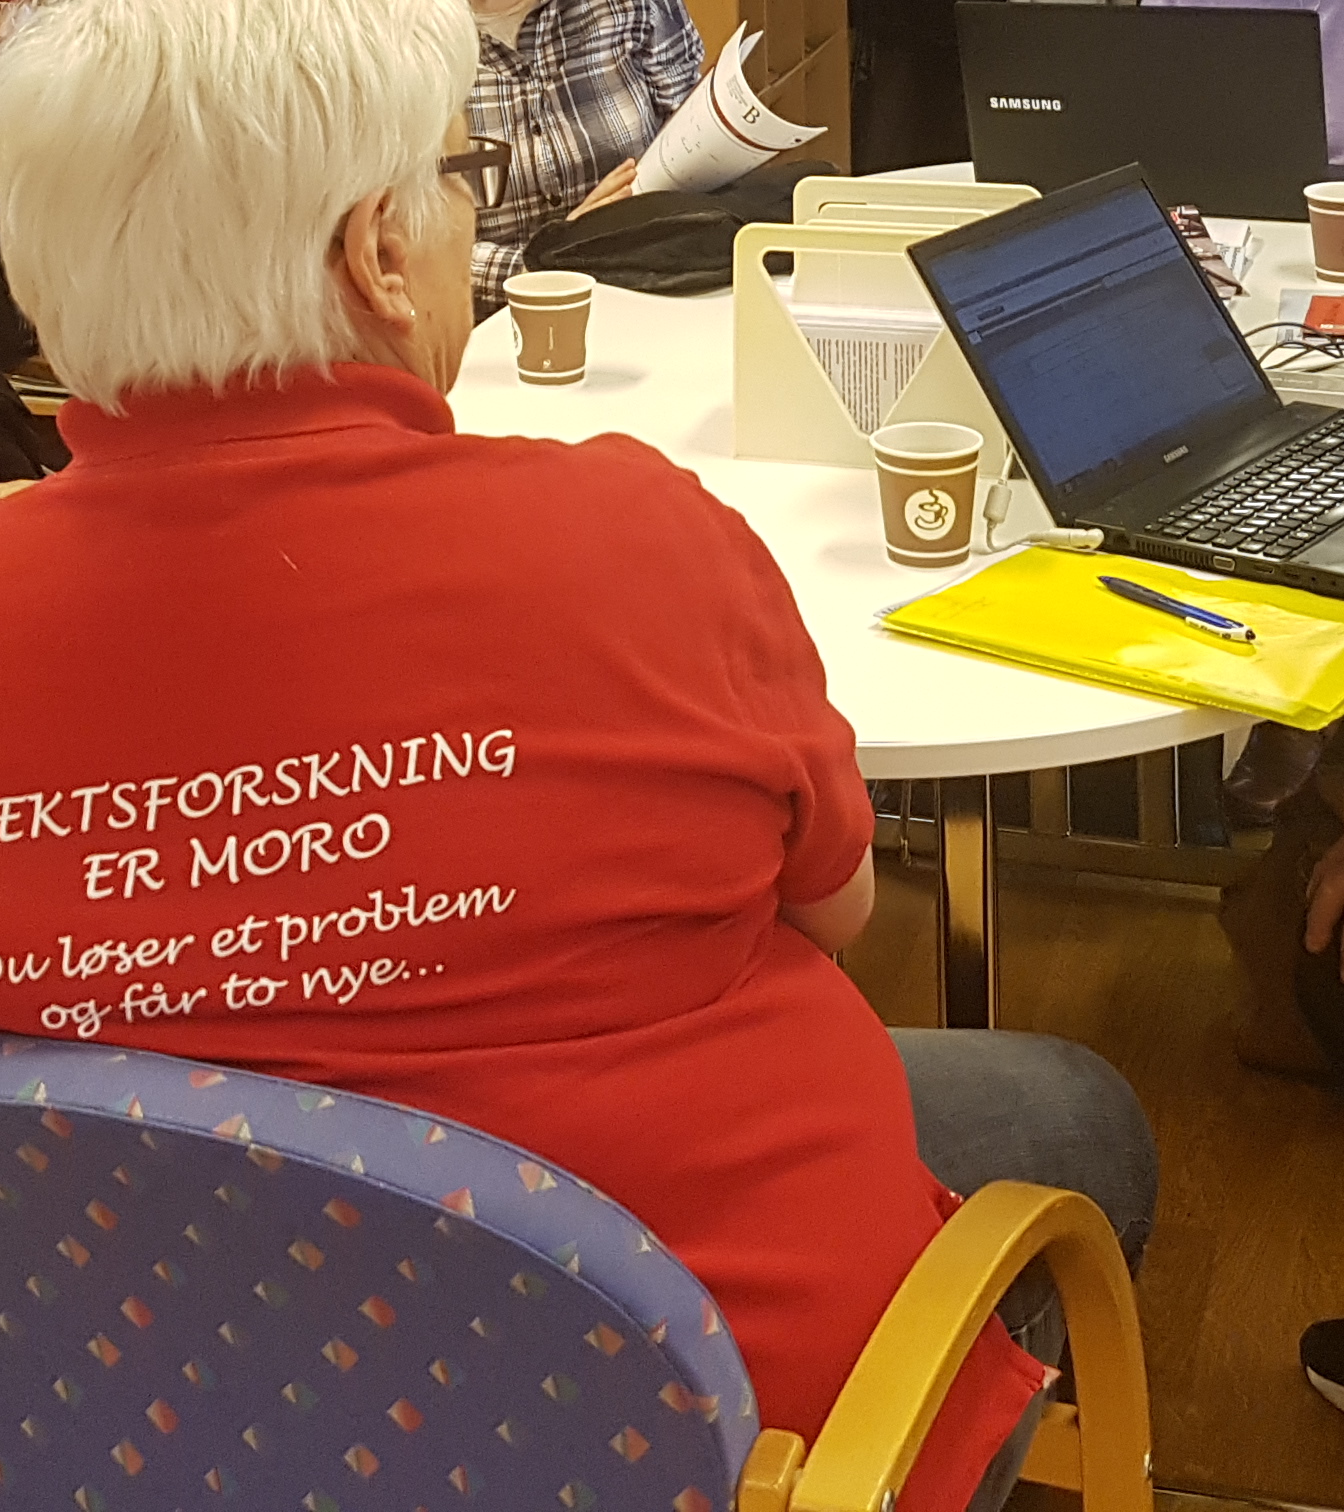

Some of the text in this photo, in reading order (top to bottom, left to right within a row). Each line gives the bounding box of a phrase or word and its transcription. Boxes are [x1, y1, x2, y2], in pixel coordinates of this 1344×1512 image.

[742, 105, 760, 124] B
[989, 97, 1062, 111] SAMSUNG
[83, 812, 392, 900] ER MORO
[58, 933, 197, 982] løser
[210, 916, 270, 957] et
[274, 884, 518, 961] problem
[40, 1001, 112, 1040] og
[118, 982, 207, 1025] får
[221, 975, 288, 1012] to
